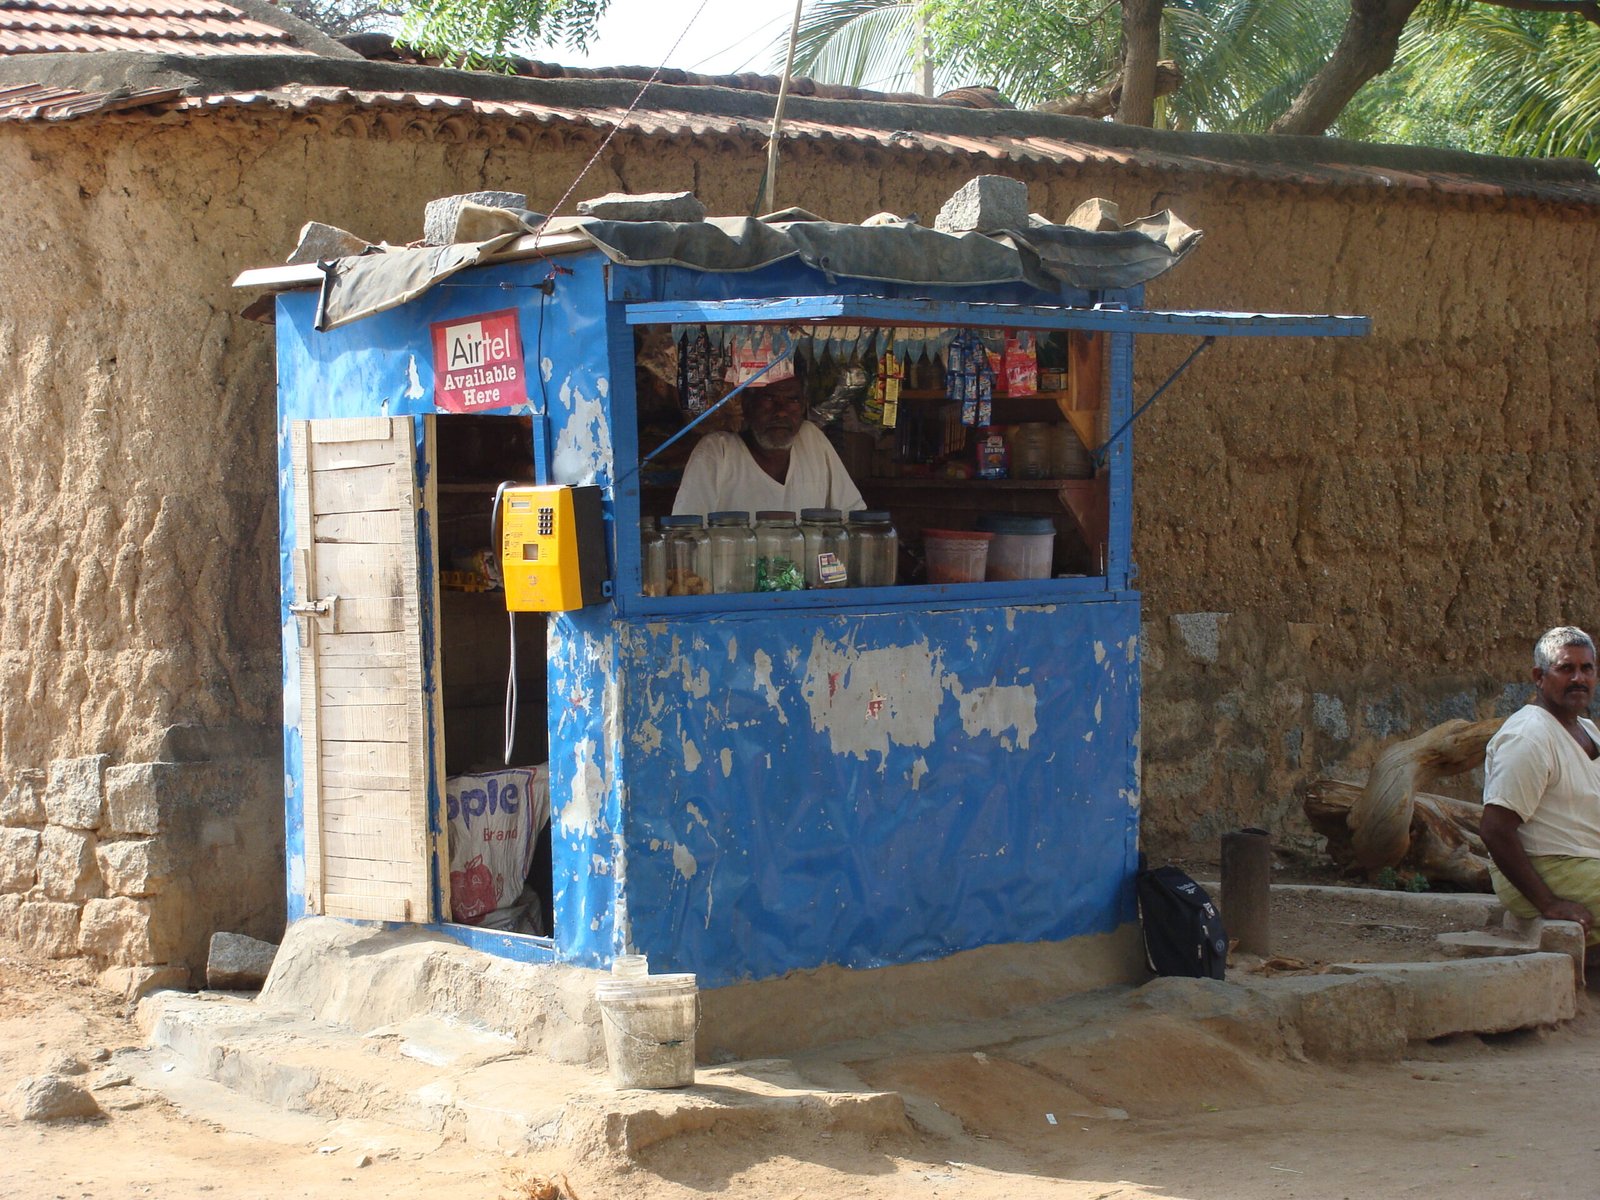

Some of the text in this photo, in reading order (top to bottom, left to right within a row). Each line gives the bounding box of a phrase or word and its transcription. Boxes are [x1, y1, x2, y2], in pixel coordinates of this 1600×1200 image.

[451, 328, 511, 368] Airtel
[444, 364, 517, 391] Available
[463, 386, 501, 406] Here
[483, 826, 518, 842] Brand
